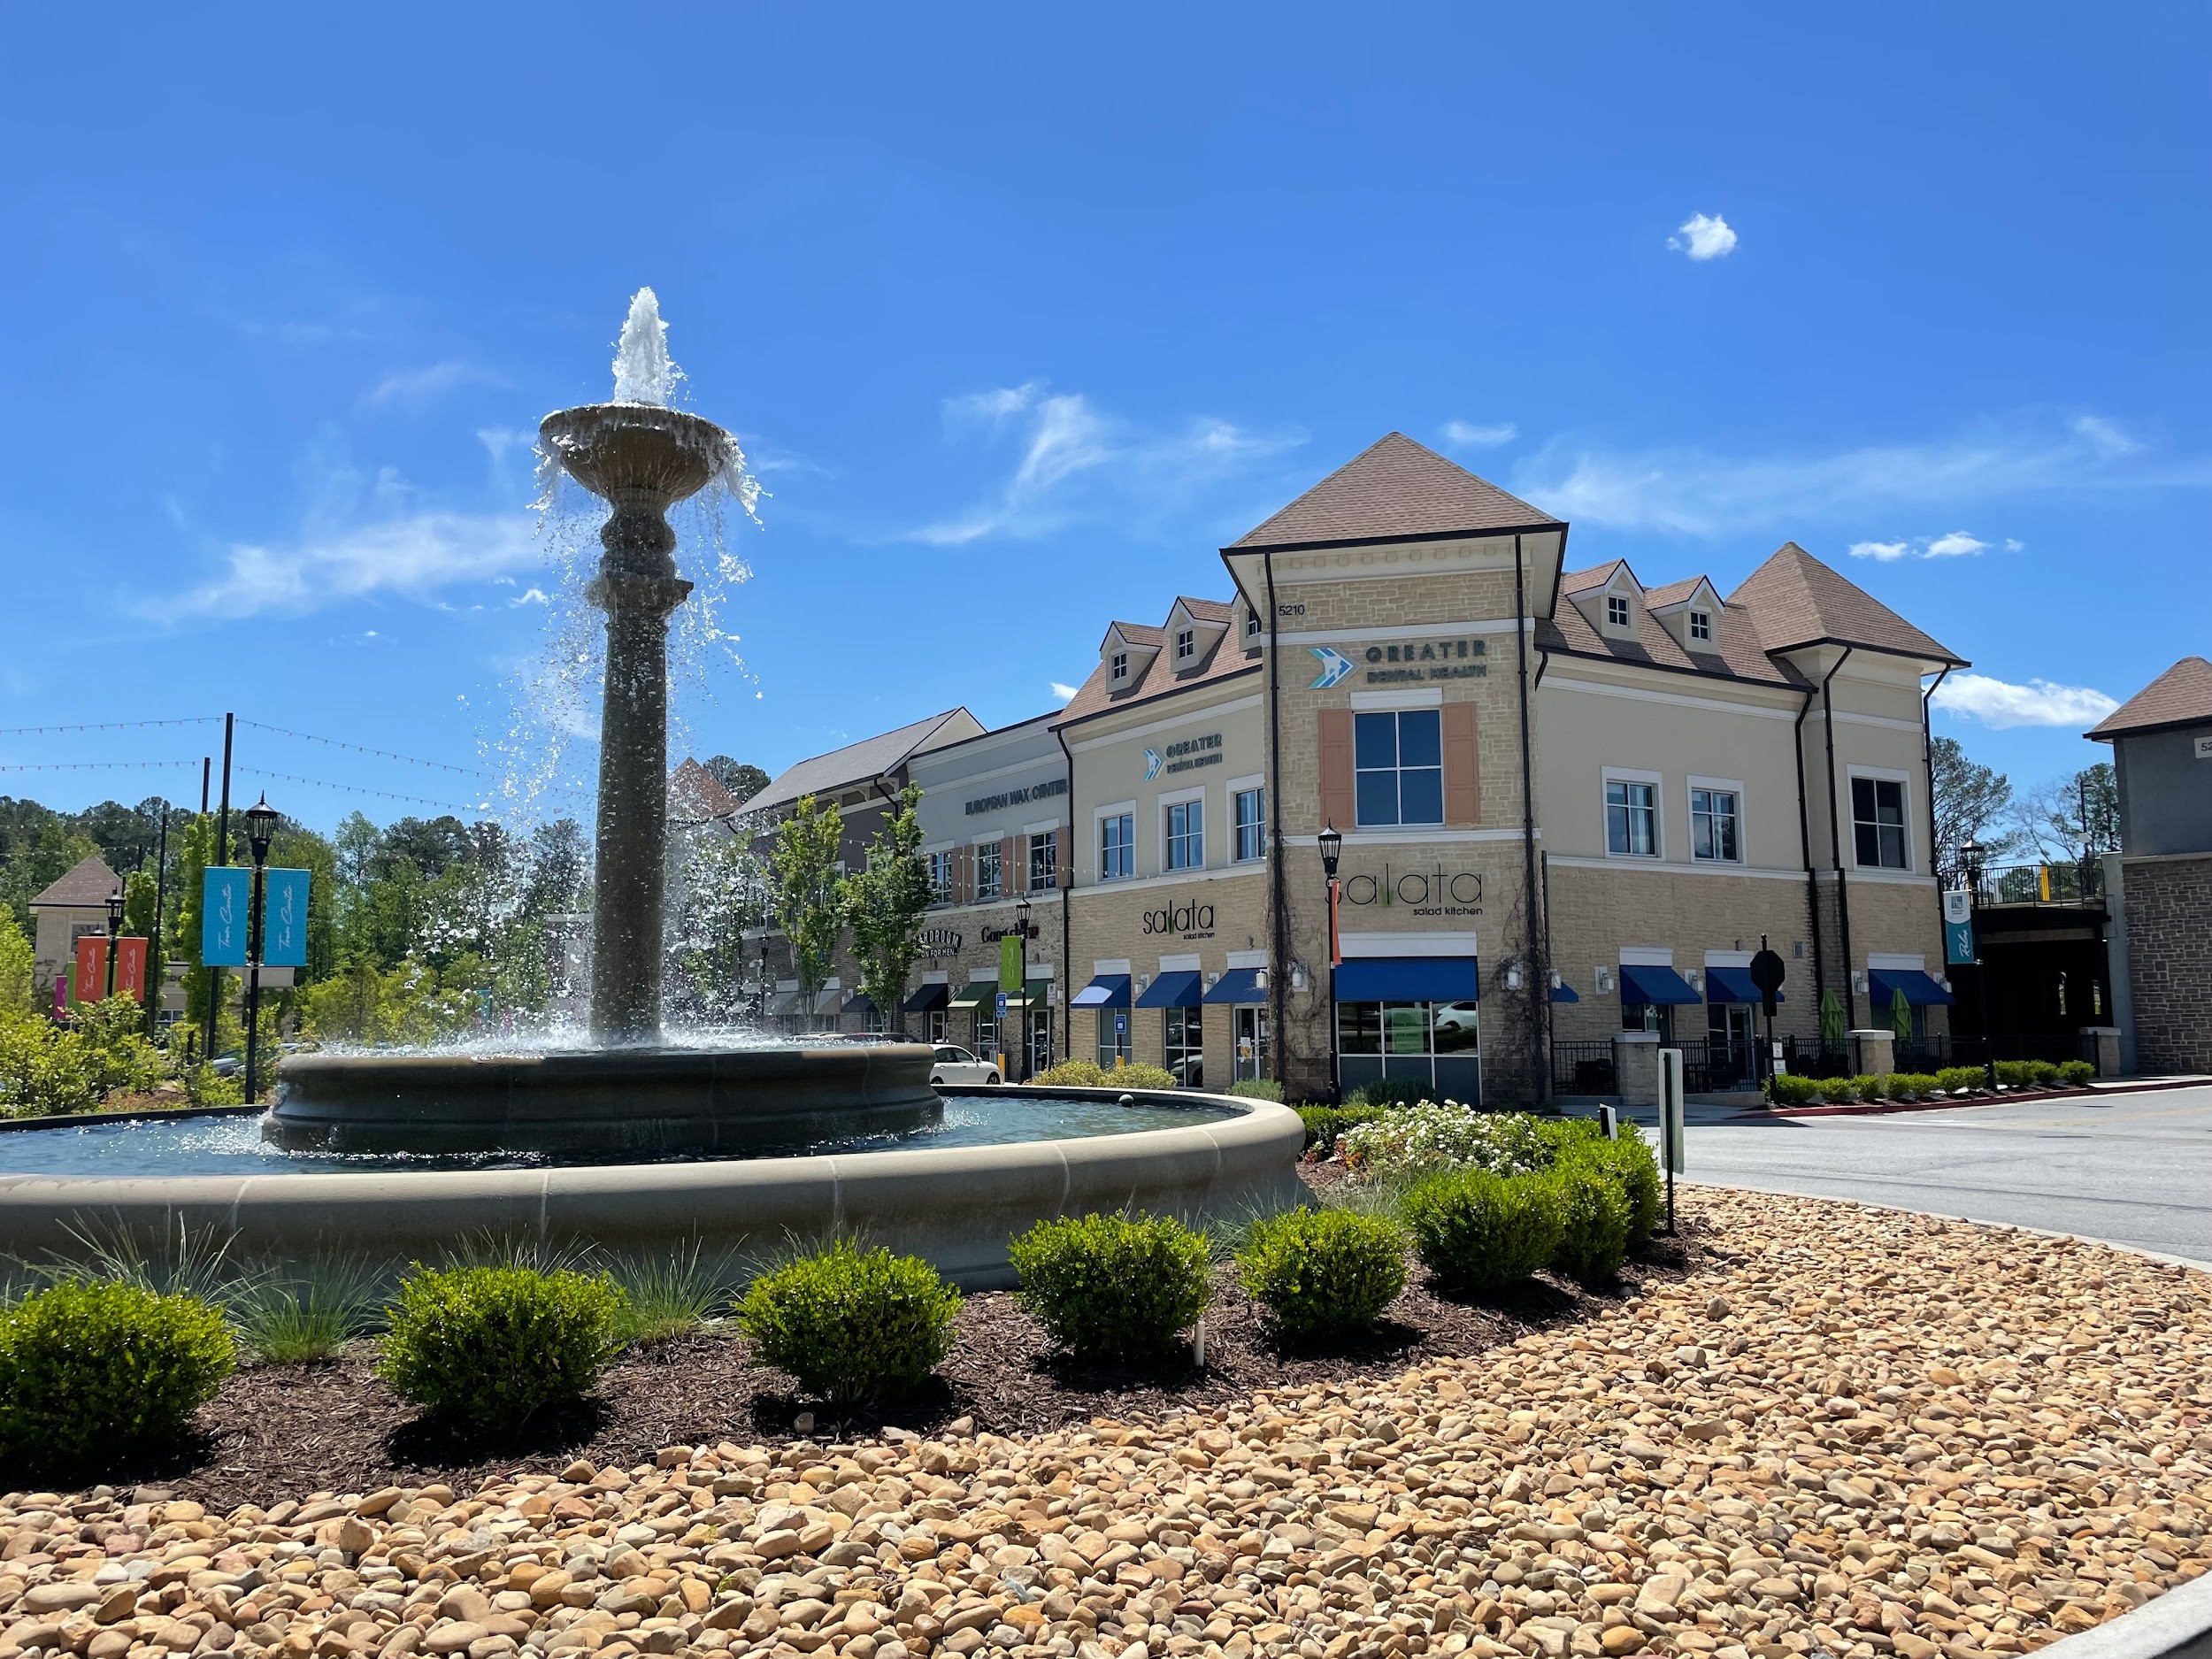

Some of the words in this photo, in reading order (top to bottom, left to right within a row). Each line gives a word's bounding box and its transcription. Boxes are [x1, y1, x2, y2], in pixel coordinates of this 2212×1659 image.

[1279, 604, 1305, 616] 5210
[1365, 640, 1486, 663] GREATER
[1367, 668, 1425, 684] DENTAL
[1430, 664, 1487, 680] HEALTH
[1165, 733, 1223, 758] GREATER
[964, 793, 1008, 815] EUROPEAN
[1009, 787, 1030, 805] WAX
[1032, 779, 1068, 801] CENTER
[1142, 898, 1214, 934] salata
[1413, 906, 1442, 916] salad
[1445, 906, 1483, 916] kitchen
[930, 949, 942, 957] FOR
